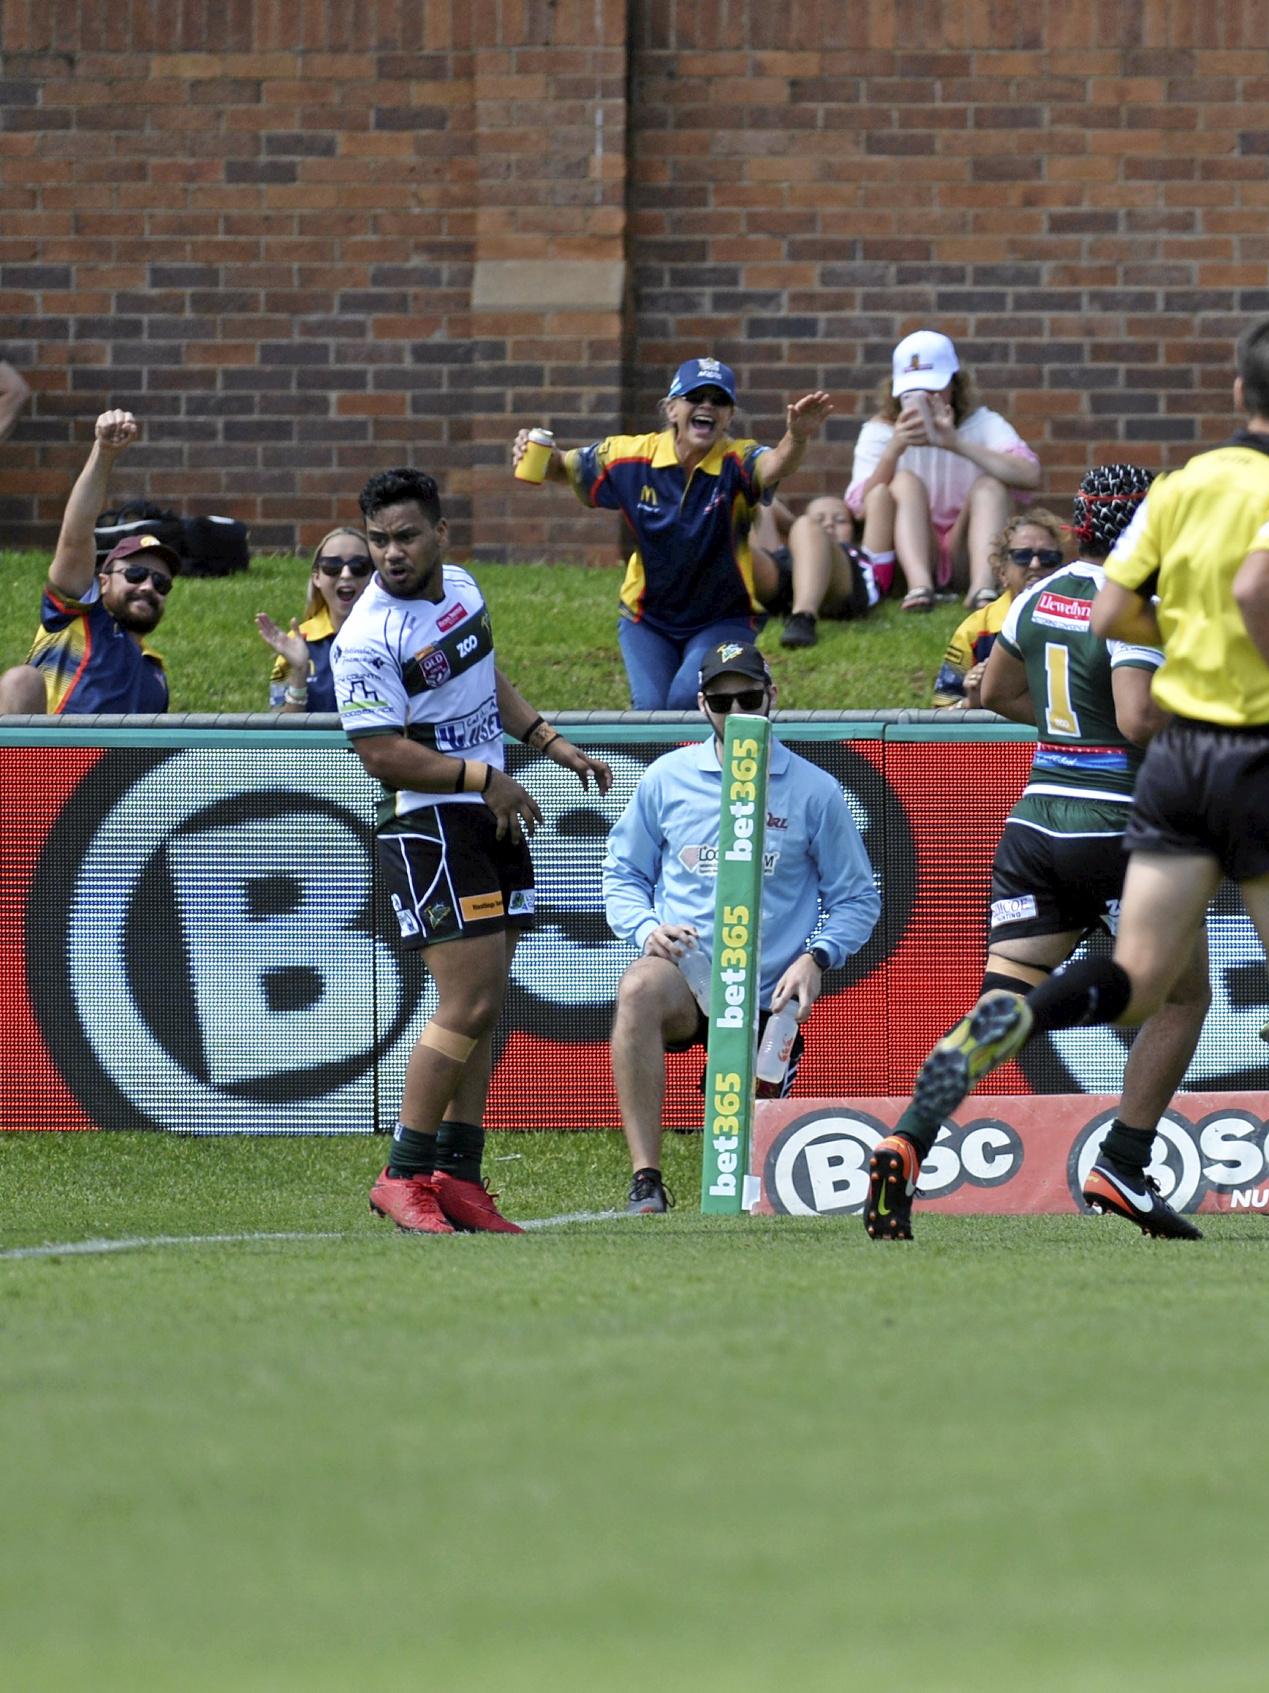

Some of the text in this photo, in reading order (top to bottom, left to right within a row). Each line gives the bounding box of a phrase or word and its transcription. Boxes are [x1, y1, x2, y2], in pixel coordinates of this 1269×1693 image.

[1039, 595, 1092, 619] Llewellyn
[1045, 642, 1082, 737] 1
[725, 738, 760, 862] bet365
[716, 904, 750, 1029] bet365
[709, 1072, 742, 1198] bet365
